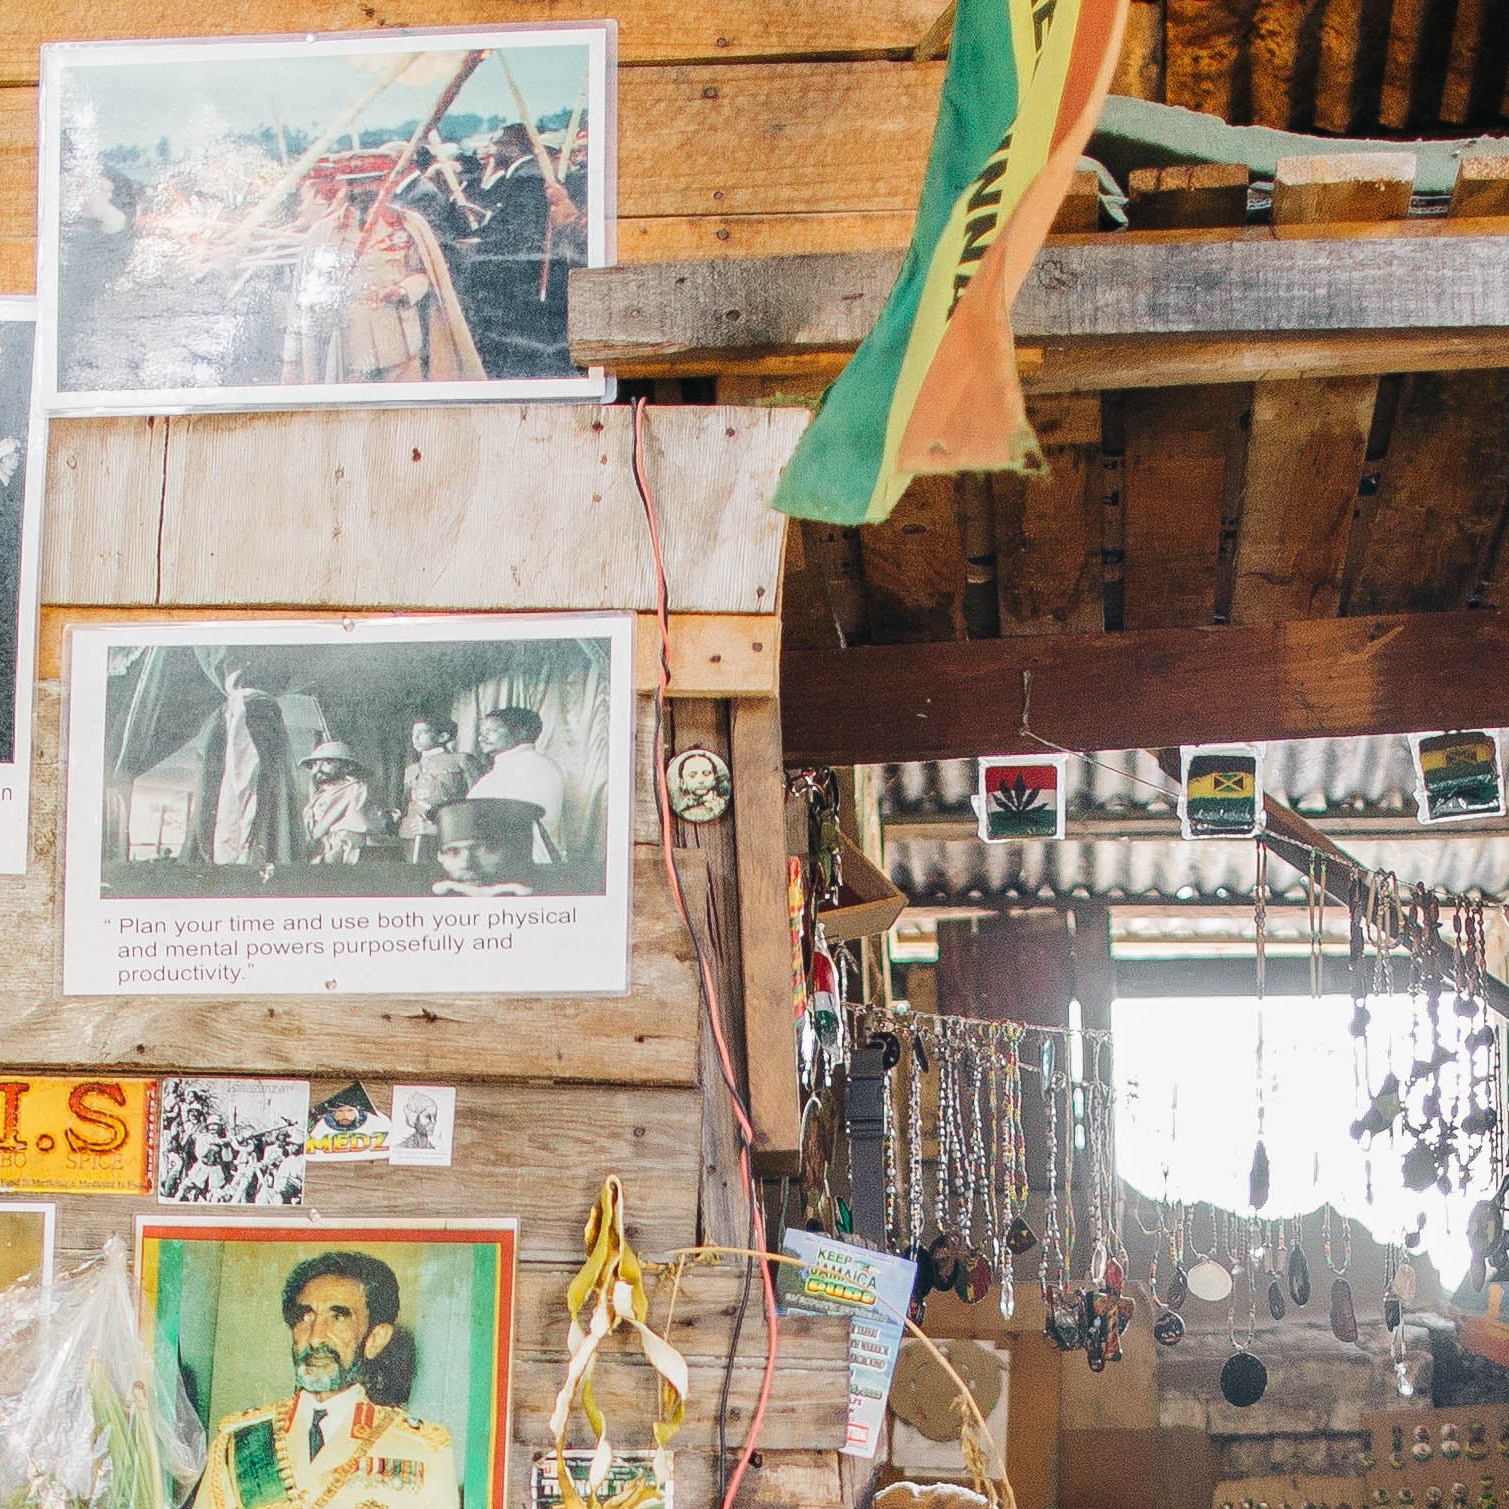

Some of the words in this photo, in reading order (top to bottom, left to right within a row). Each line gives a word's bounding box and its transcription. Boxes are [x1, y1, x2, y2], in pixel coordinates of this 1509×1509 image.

[119, 917, 167, 935] Plan
[174, 918, 221, 938] your
[228, 915, 275, 932] time
[283, 913, 323, 931] and
[330, 915, 370, 931] use
[377, 911, 425, 929] both
[432, 912, 481, 933] your
[488, 907, 577, 930] physical
[117, 941, 157, 959] and
[165, 940, 239, 958] mental
[246, 939, 324, 961] powers
[332, 934, 465, 958] purposefully
[472, 932, 513, 951] and
[117, 962, 255, 988] productivity.”
[66, 1152, 124, 1170] SPICE
[817, 1247, 853, 1265] KEEP
